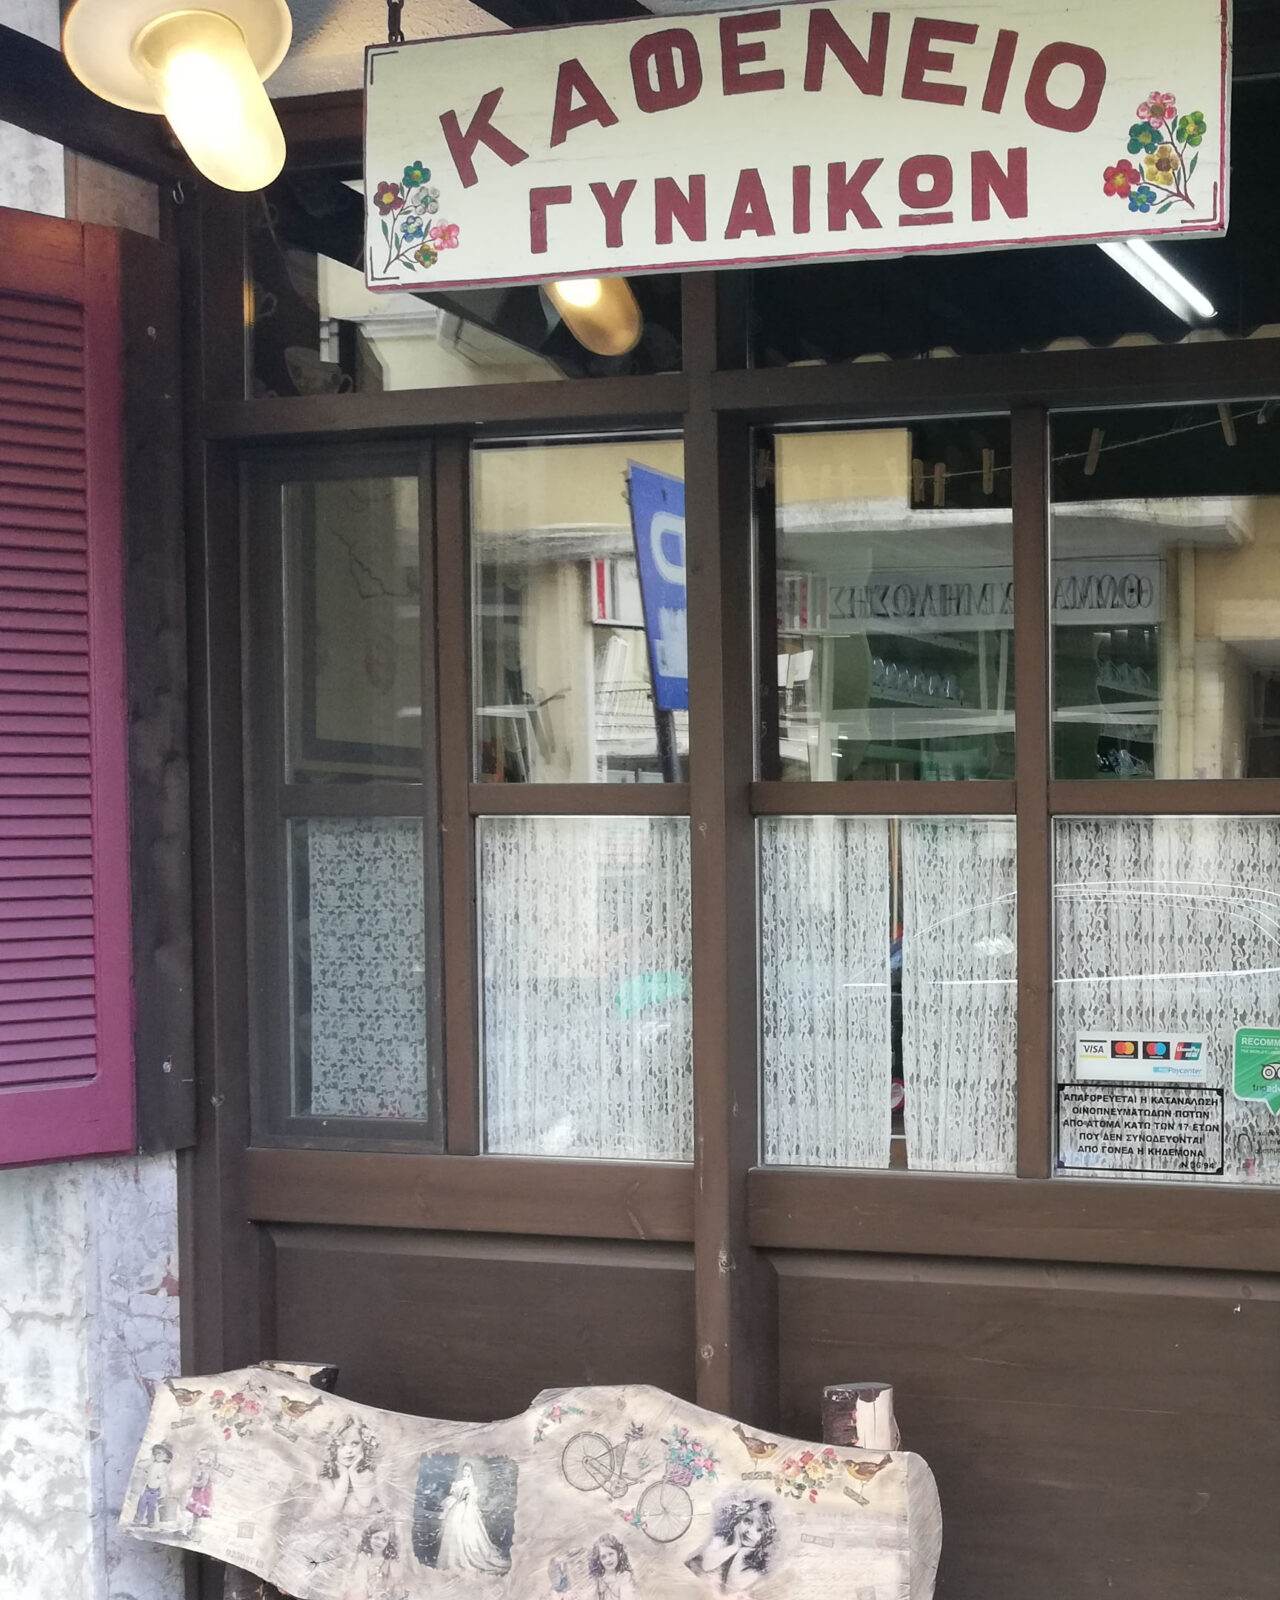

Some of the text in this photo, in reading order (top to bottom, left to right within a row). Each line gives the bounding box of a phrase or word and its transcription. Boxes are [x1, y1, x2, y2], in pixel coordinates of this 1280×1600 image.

[439, 8, 1108, 188] ΚΑΦΕΝΕΙΟ
[528, 147, 1029, 255] ΓΥΝΑΙΚΩΝ
[1083, 1045, 1104, 1054] VISA
[1063, 1094, 1219, 1106] ΑΠΑΓΟΡΕΥΕΤΑΙ Η ΚΑΤΑΝΑΛΩΣΗ
[1072, 1106, 1210, 1119] ΟΙΝΟΠΝΕΥΜΑΤΩΔΩΝ ΠΟΤΩΝ
[1063, 1119, 1220, 1133] ΑΠΟ ΑΤΟΜΑ ΚΑΤΩ ΤΩΝ 17 ΕΤΩΝ
[1079, 1132, 1203, 1145] ΠΟΥ ΔΕΝ ΣΥΝΟΔΕΥΟΝΤΑΙ
[1078, 1145, 1205, 1158] ΑΠΟ ΓΟΝΕΑ Η ΚΗΔΕΜΟΝΑ
